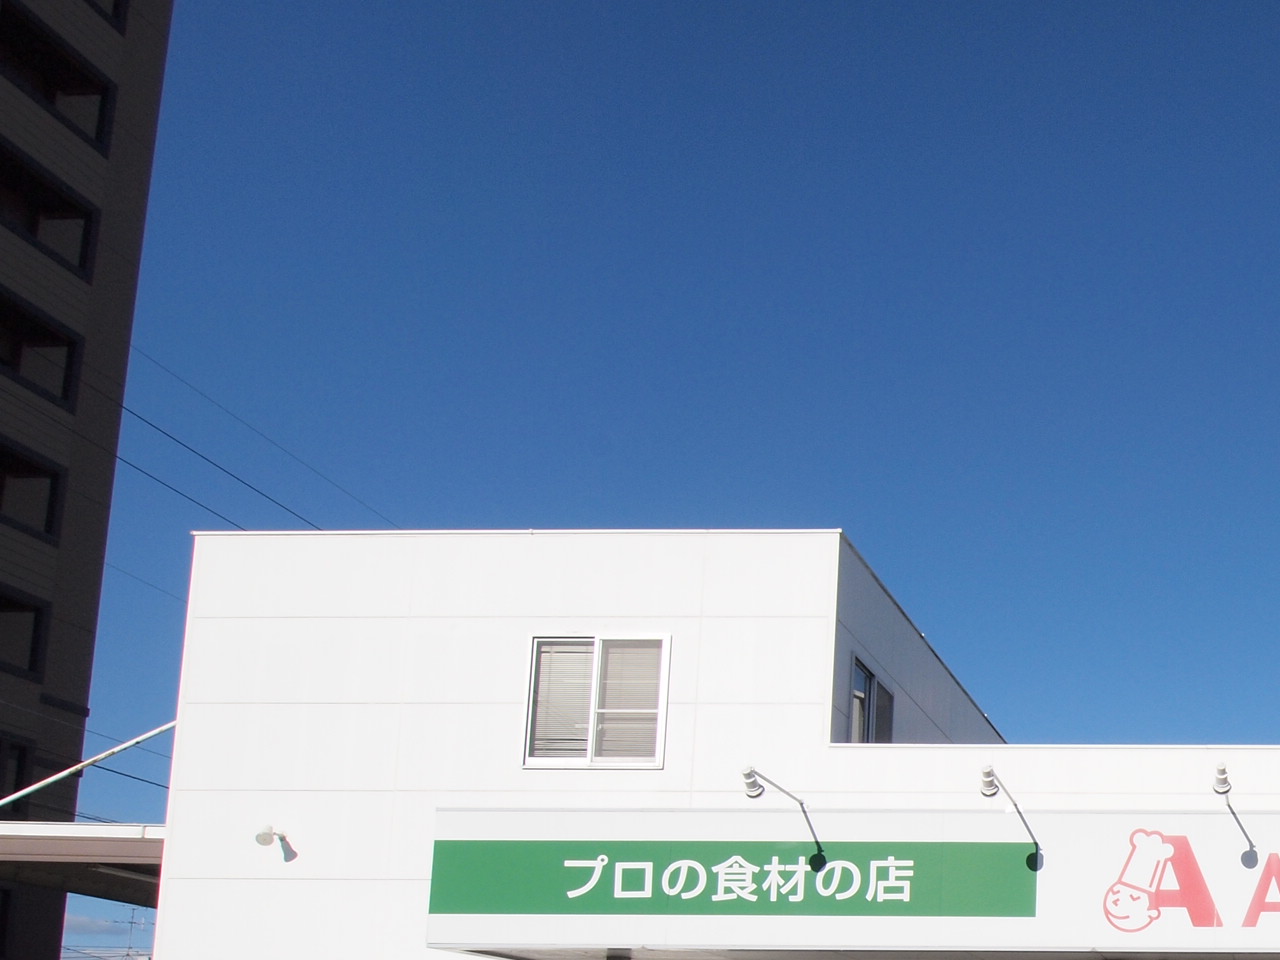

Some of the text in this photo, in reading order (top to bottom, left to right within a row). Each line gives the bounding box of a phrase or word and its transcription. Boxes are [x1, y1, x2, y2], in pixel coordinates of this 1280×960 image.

[563, 854, 915, 902] プロの食材の店
